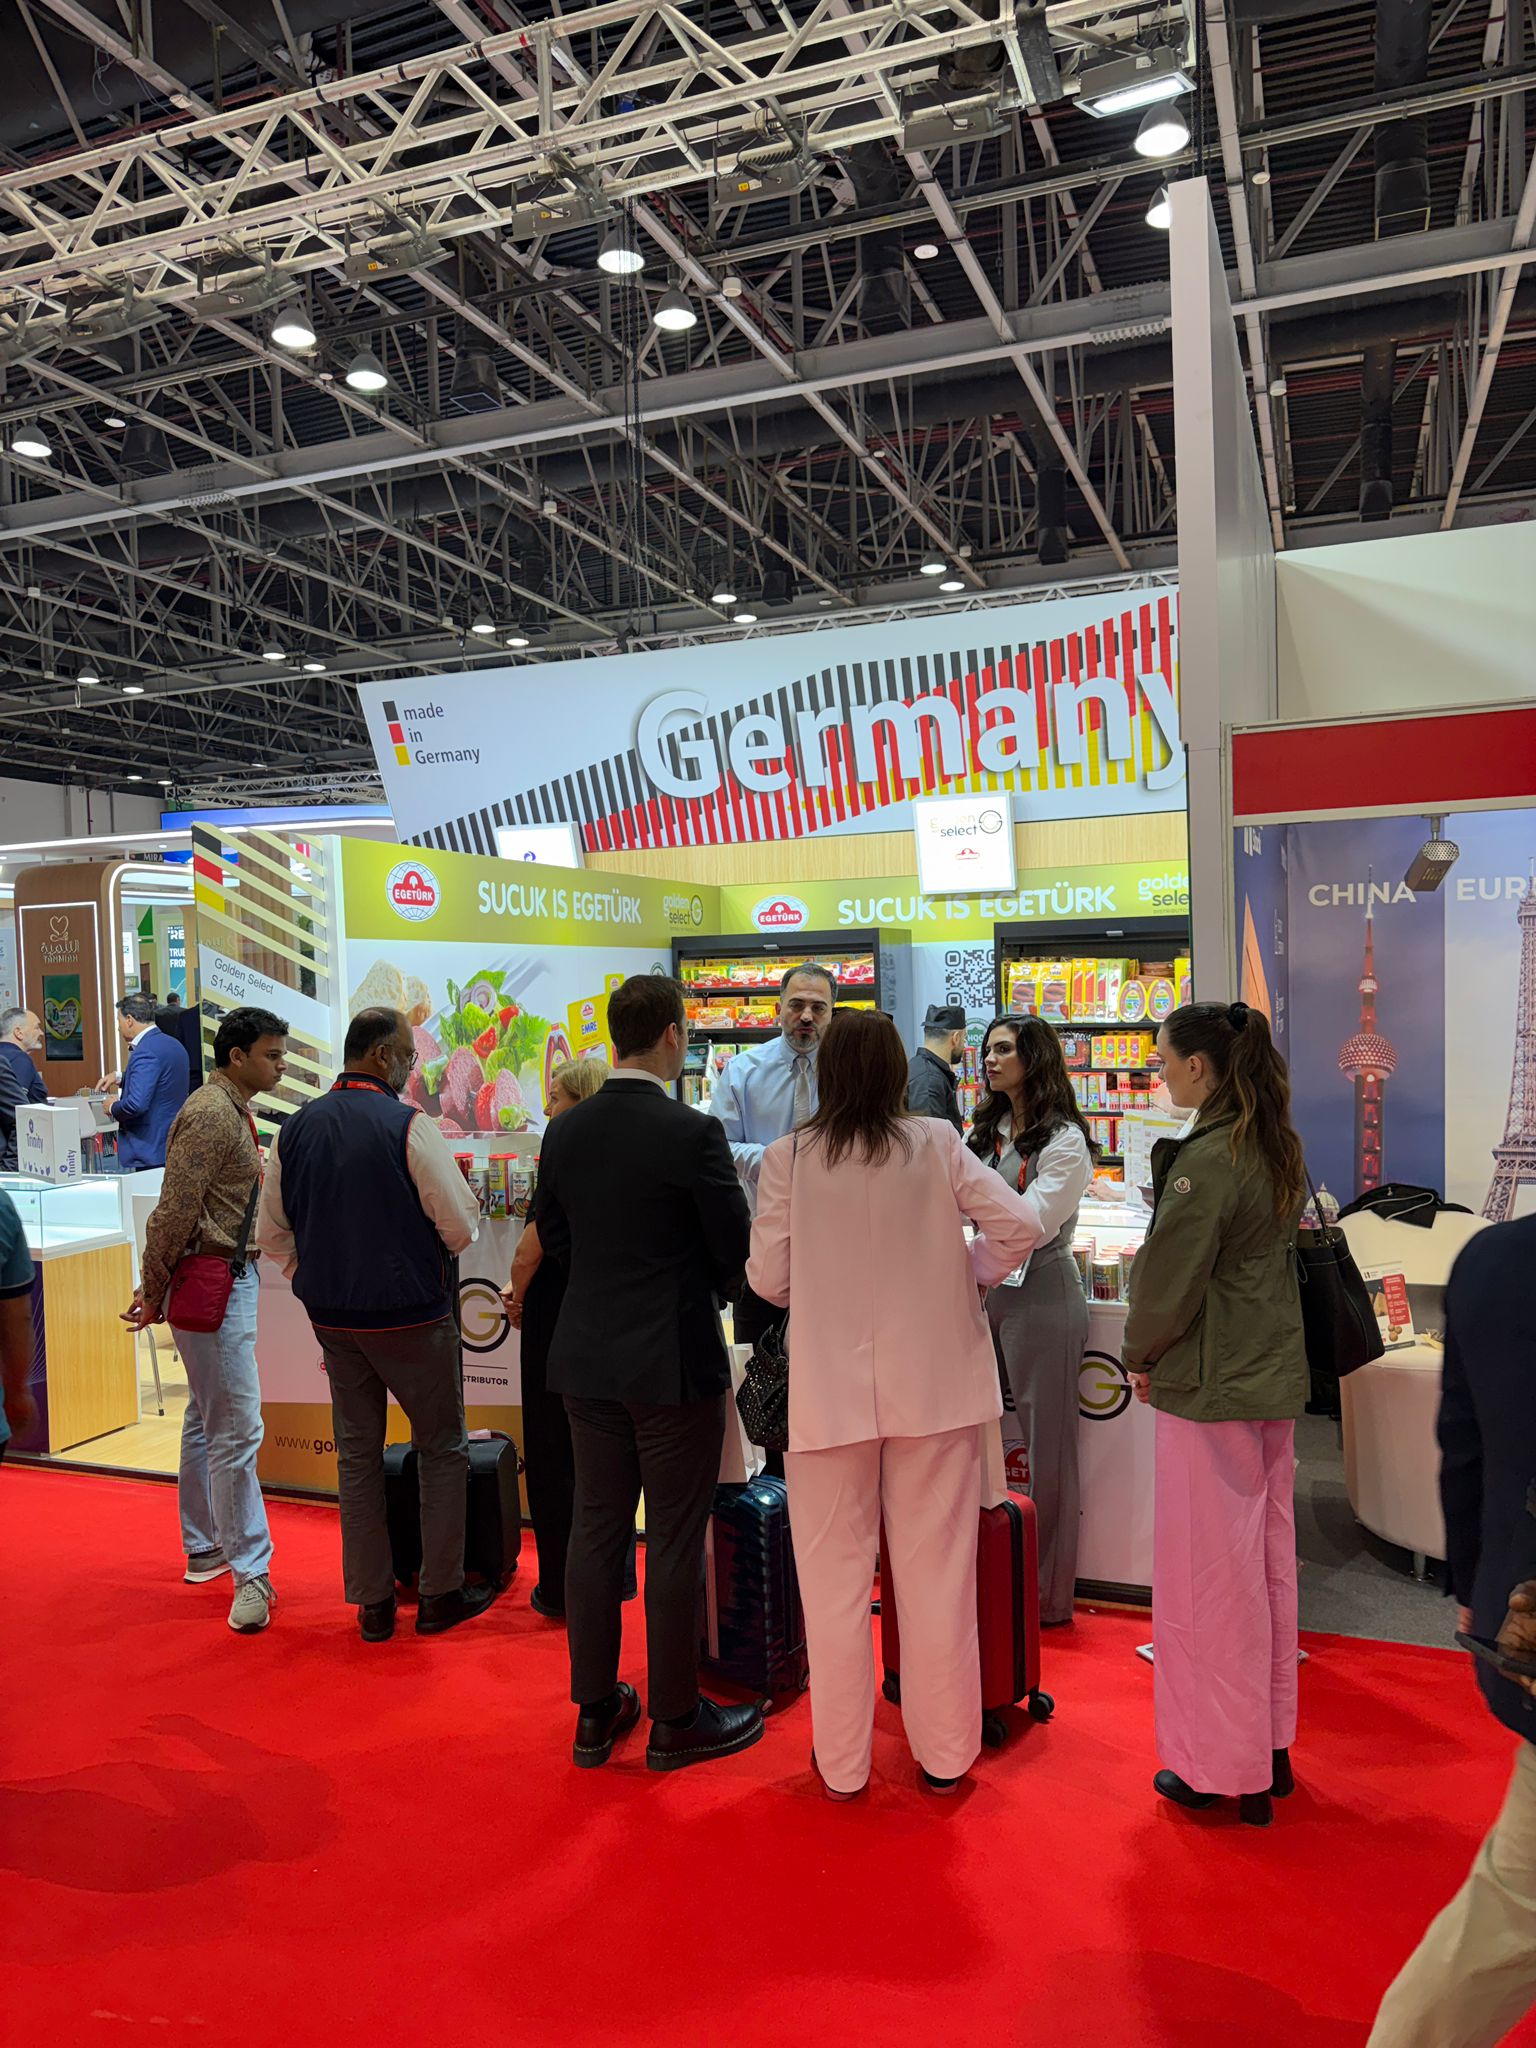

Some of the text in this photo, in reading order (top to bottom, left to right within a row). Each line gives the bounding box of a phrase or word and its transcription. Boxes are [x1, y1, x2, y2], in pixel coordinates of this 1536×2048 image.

[403, 702, 444, 720] made
[408, 728, 423, 742] in
[638, 671, 1187, 799] Germany
[415, 748, 480, 764] Germany
[940, 825, 977, 837] select
[394, 888, 434, 901] EGETÜRK
[1152, 889, 1188, 906] sele
[1308, 881, 1417, 906] CHINA
[1457, 876, 1536, 900] EUR
[478, 880, 642, 924] SUCUK IS EGETÜRK
[838, 881, 1117, 924] SUCUK IS EGETÜRK
[669, 909, 690, 924] select
[759, 912, 800, 922] EGETÜRK
[214, 958, 274, 995] Golden Select
[210, 975, 246, 999] S1-A54
[581, 1021, 598, 1036] EMRE
[27, 1133, 44, 1154] Trinity
[67, 1149, 77, 1178] Trinity
[463, 1375, 509, 1386] STRIBUTOR
[274, 1434, 338, 1454] www.gol
